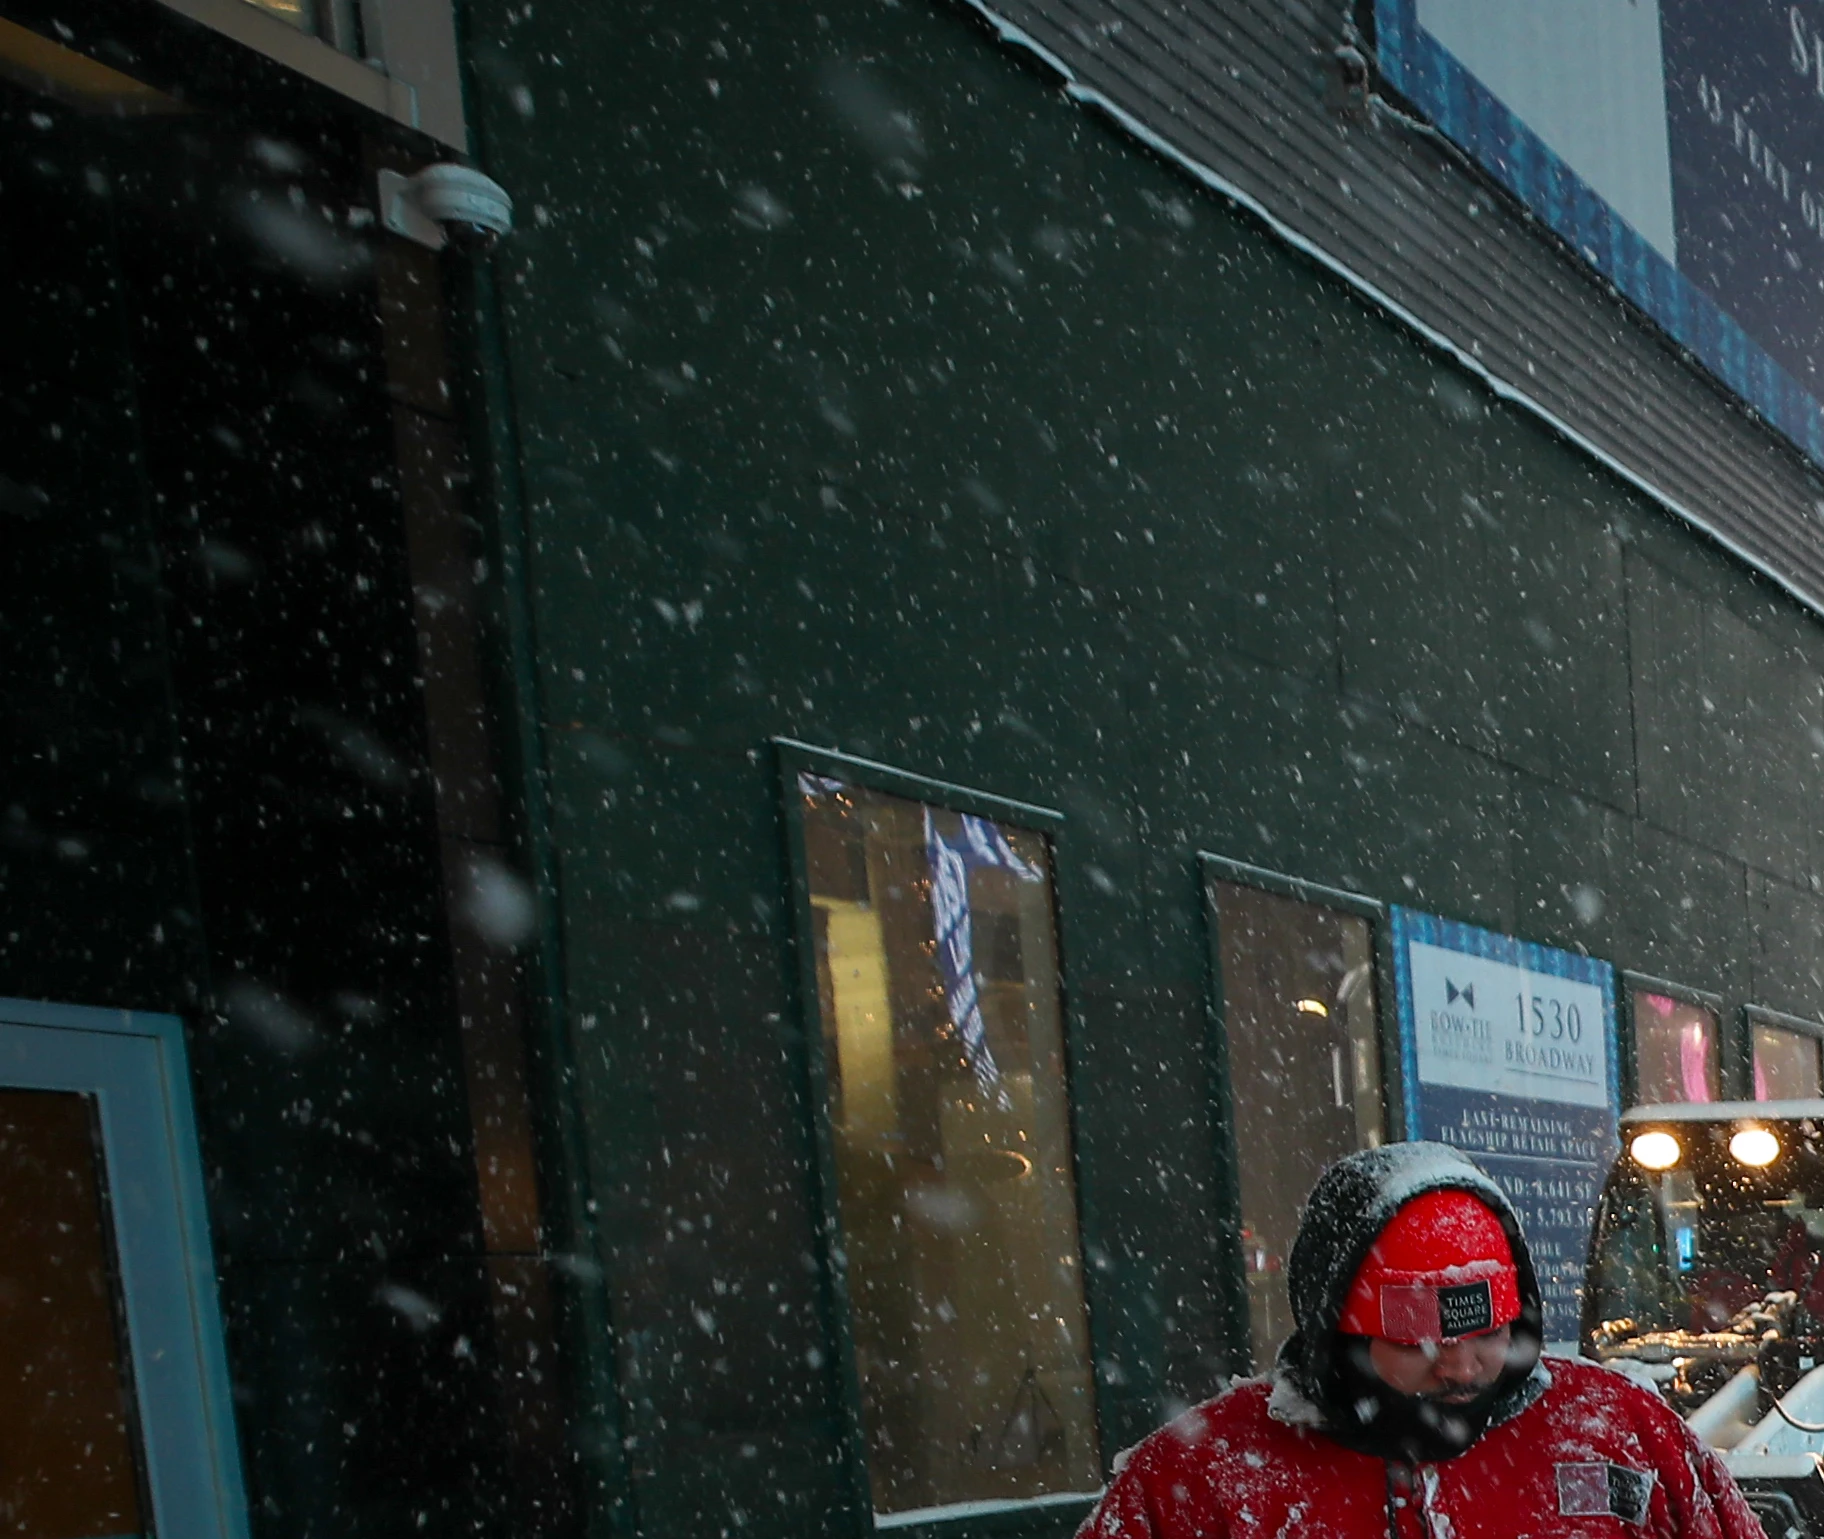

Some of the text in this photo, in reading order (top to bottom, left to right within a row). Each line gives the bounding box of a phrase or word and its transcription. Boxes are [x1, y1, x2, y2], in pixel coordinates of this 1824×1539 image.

[1732, 106, 1791, 209] FEET
[1515, 992, 1582, 1043] 1530
[1505, 1039, 1595, 1076] BROADWAY
[1441, 1125, 1597, 1157] FLAGSHIP RETAIL SPACE
[1443, 1303, 1488, 1320] SQUARE
[1446, 1293, 1484, 1308] TIMES
